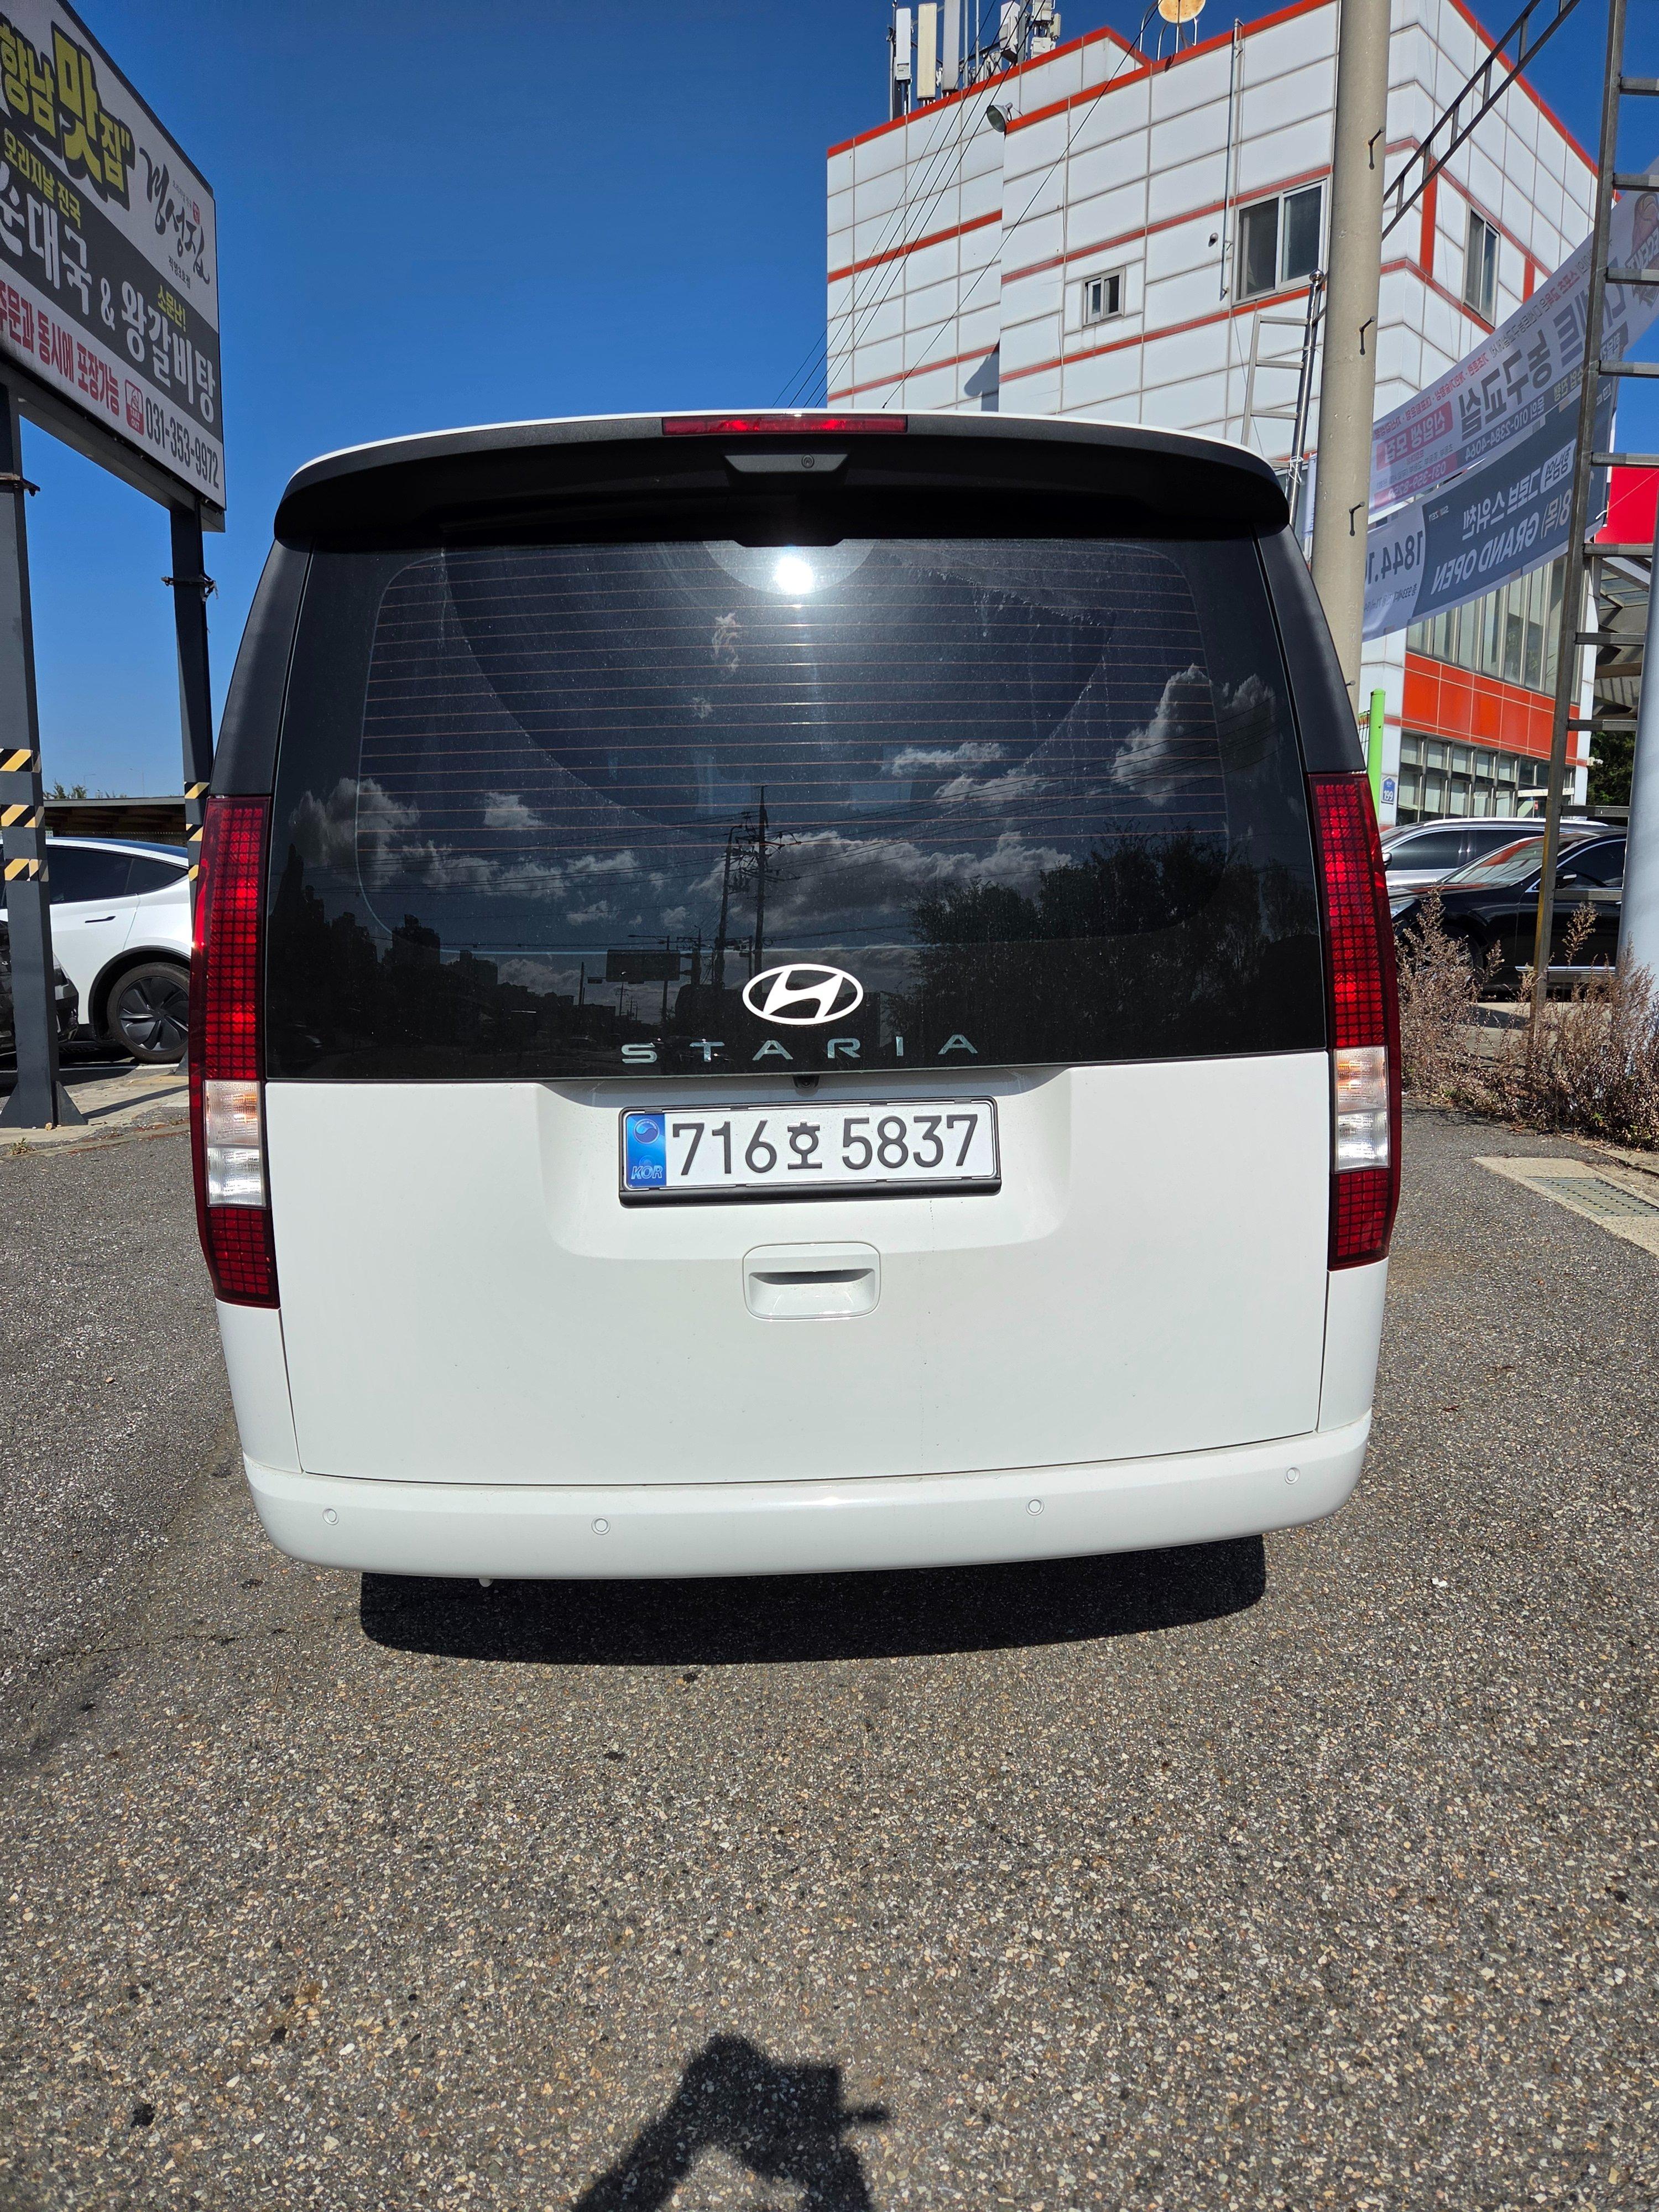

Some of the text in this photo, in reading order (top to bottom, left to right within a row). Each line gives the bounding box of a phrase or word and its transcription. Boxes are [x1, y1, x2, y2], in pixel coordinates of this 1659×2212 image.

[4, 127, 81, 229] 오리지날 진국
[157, 285, 186, 332] 소문난!
[38, 310, 74, 383] 동시에
[77, 341, 119, 416] 포장가능
[101, 278, 115, 331] &
[122, 281, 216, 423] 왕갈비탕
[145, 397, 220, 489] 031-353-9972
[1384, 790, 1393, 801] 199
[621, 1034, 978, 1065] STARIA
[631, 1165, 663, 1180] KOR
[672, 1114, 978, 1176] 716호 5837
